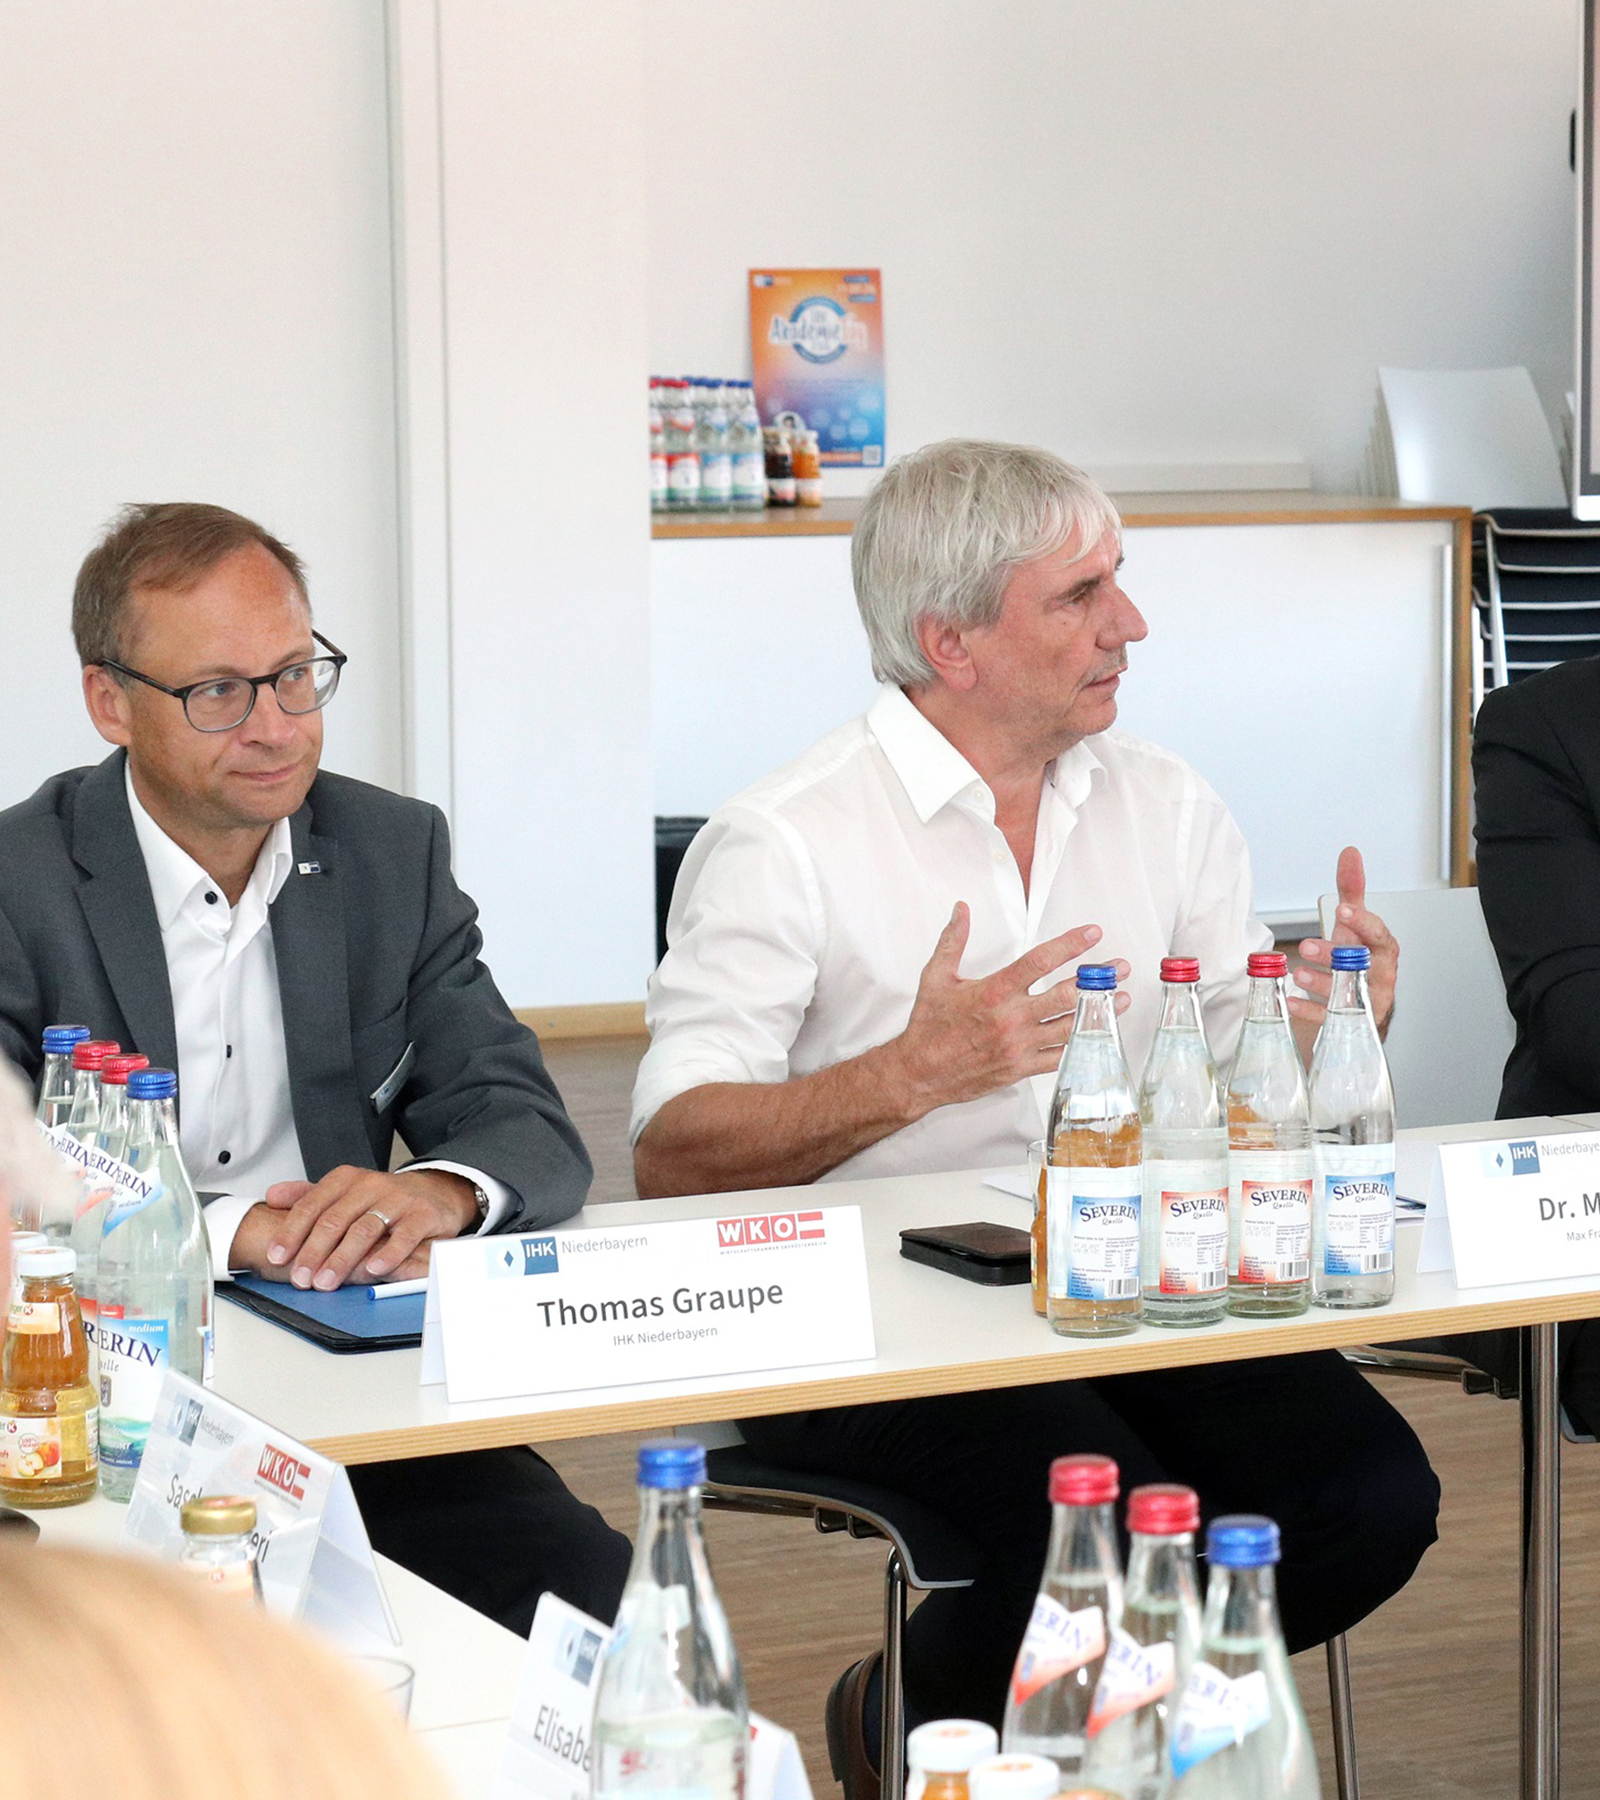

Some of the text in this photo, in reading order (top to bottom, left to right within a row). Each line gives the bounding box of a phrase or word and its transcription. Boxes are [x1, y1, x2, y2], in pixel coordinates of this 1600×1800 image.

[1512, 1145, 1536, 1160] IHK
[1250, 1189, 1308, 1207] SEVERIN
[1332, 1182, 1390, 1201] SEVERIN
[1079, 1205, 1138, 1222] SEVERIN
[1170, 1198, 1226, 1217] SEVERIN
[1539, 1197, 1575, 1221] Dr.
[718, 1217, 794, 1243] WKO
[1566, 1231, 1586, 1241] Max
[526, 1235, 648, 1258] IHK Niederbayern
[537, 1284, 783, 1327] Thomas Graupe
[128, 1323, 164, 1333] medium
[613, 1326, 718, 1346] IHK Niederbayern
[100, 1328, 162, 1367] ERIN
[260, 1447, 297, 1487] WKO
[534, 1704, 592, 1772] Elisabe
